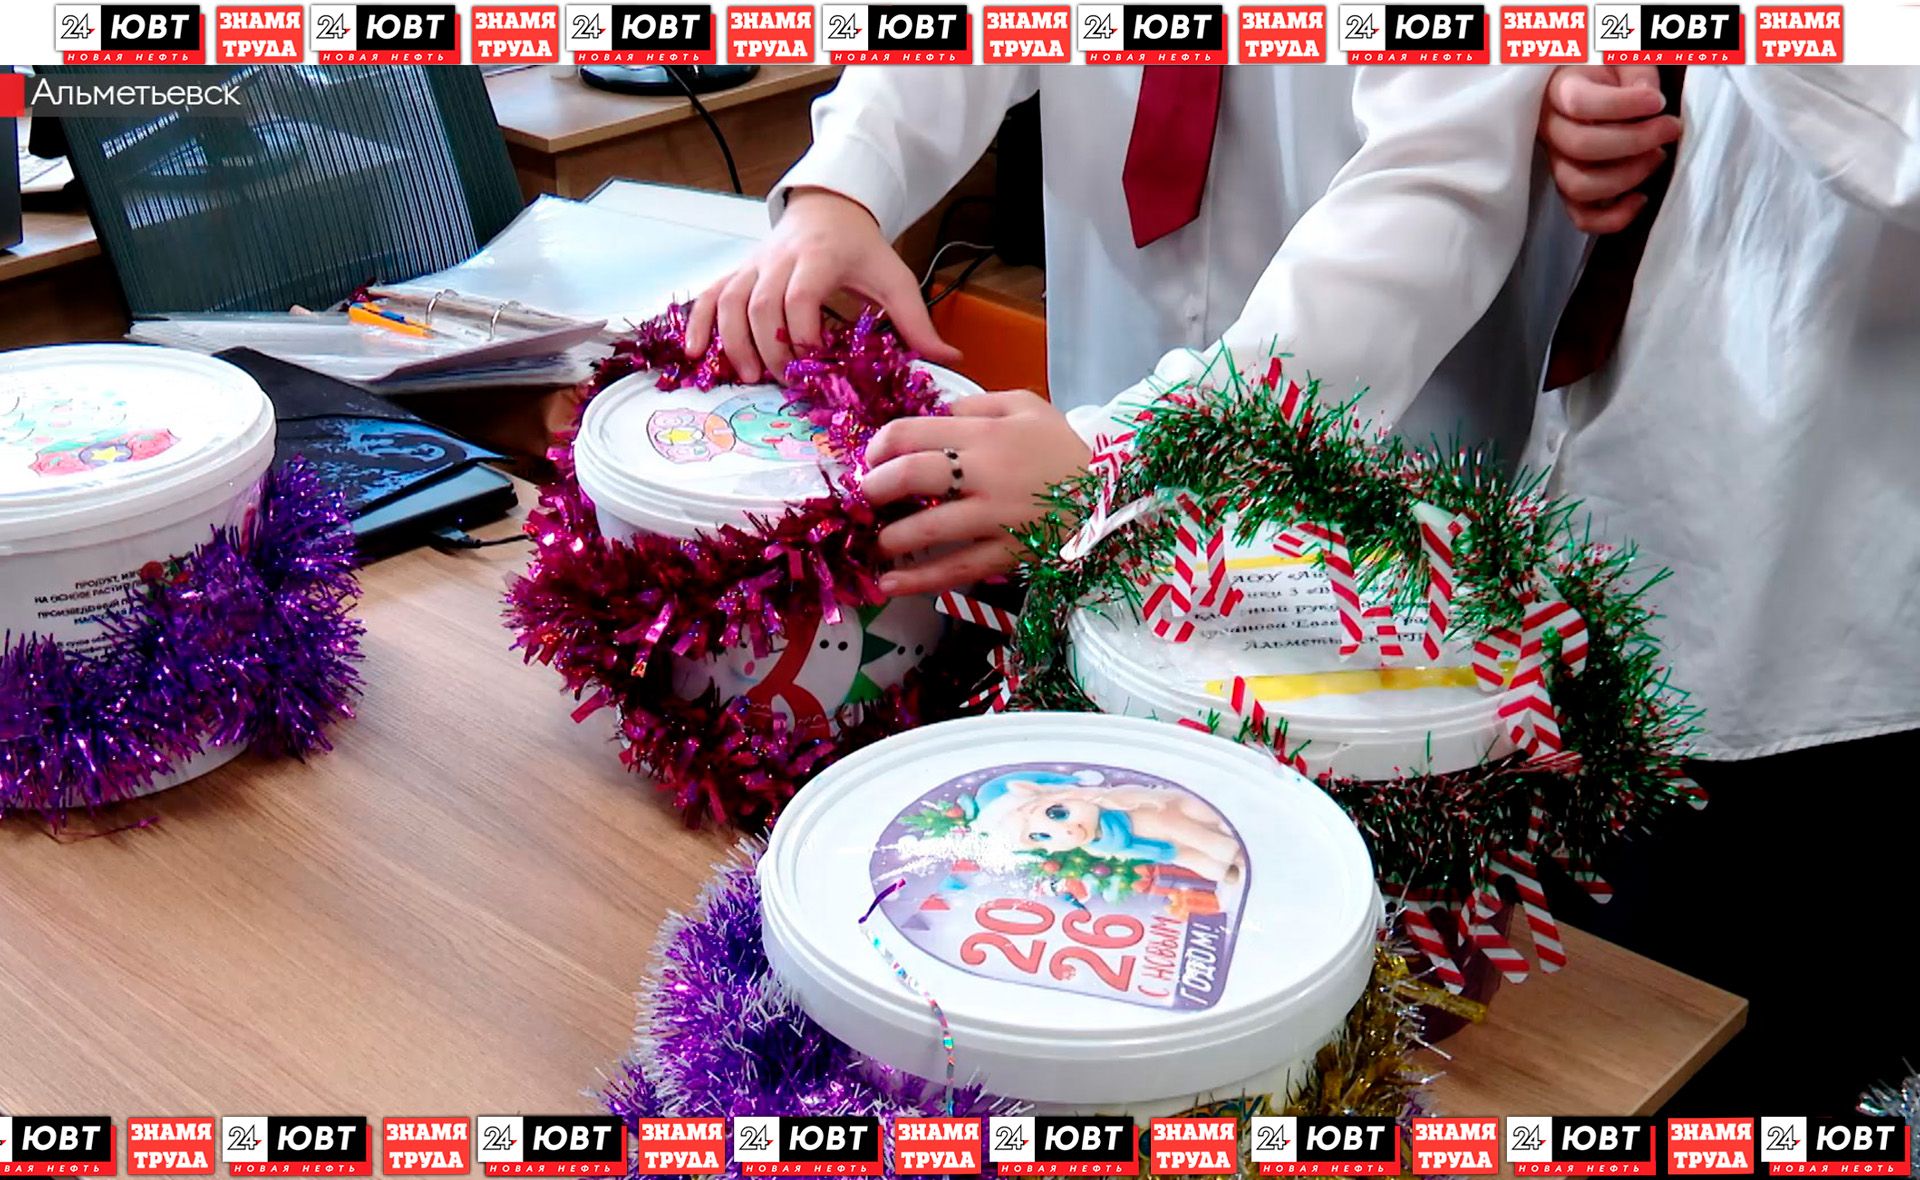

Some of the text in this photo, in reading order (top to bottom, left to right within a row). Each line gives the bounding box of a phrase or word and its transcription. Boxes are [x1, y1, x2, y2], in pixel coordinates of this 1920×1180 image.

[960, 897, 1056, 976] 20
[1048, 910, 1145, 993] 26
[1137, 915, 1182, 998] С НОВЫМ
[1179, 922, 1220, 1006] ГОДОМ!
